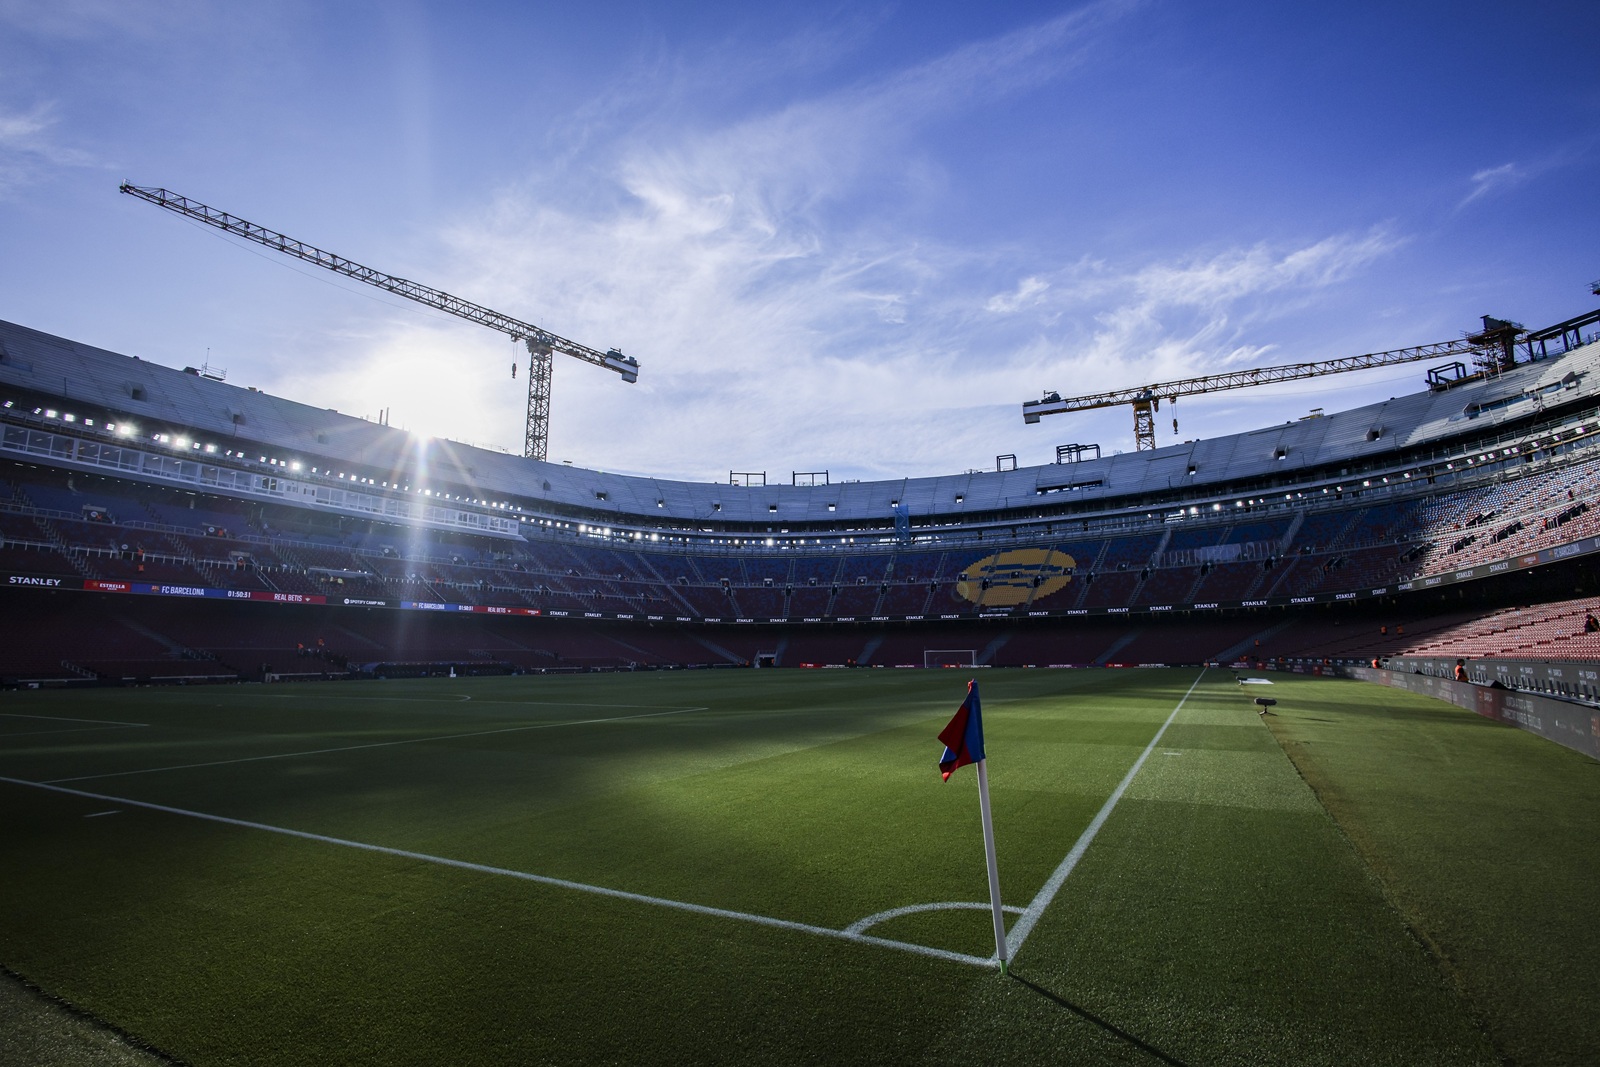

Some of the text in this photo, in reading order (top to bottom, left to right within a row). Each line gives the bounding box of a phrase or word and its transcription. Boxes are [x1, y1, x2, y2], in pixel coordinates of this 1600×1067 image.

[10, 577, 61, 586] STANLEY
[162, 586, 205, 596] FC BARCELONA
[227, 590, 251, 599] 01:50:31
[274, 593, 303, 602] REAL BETIS
